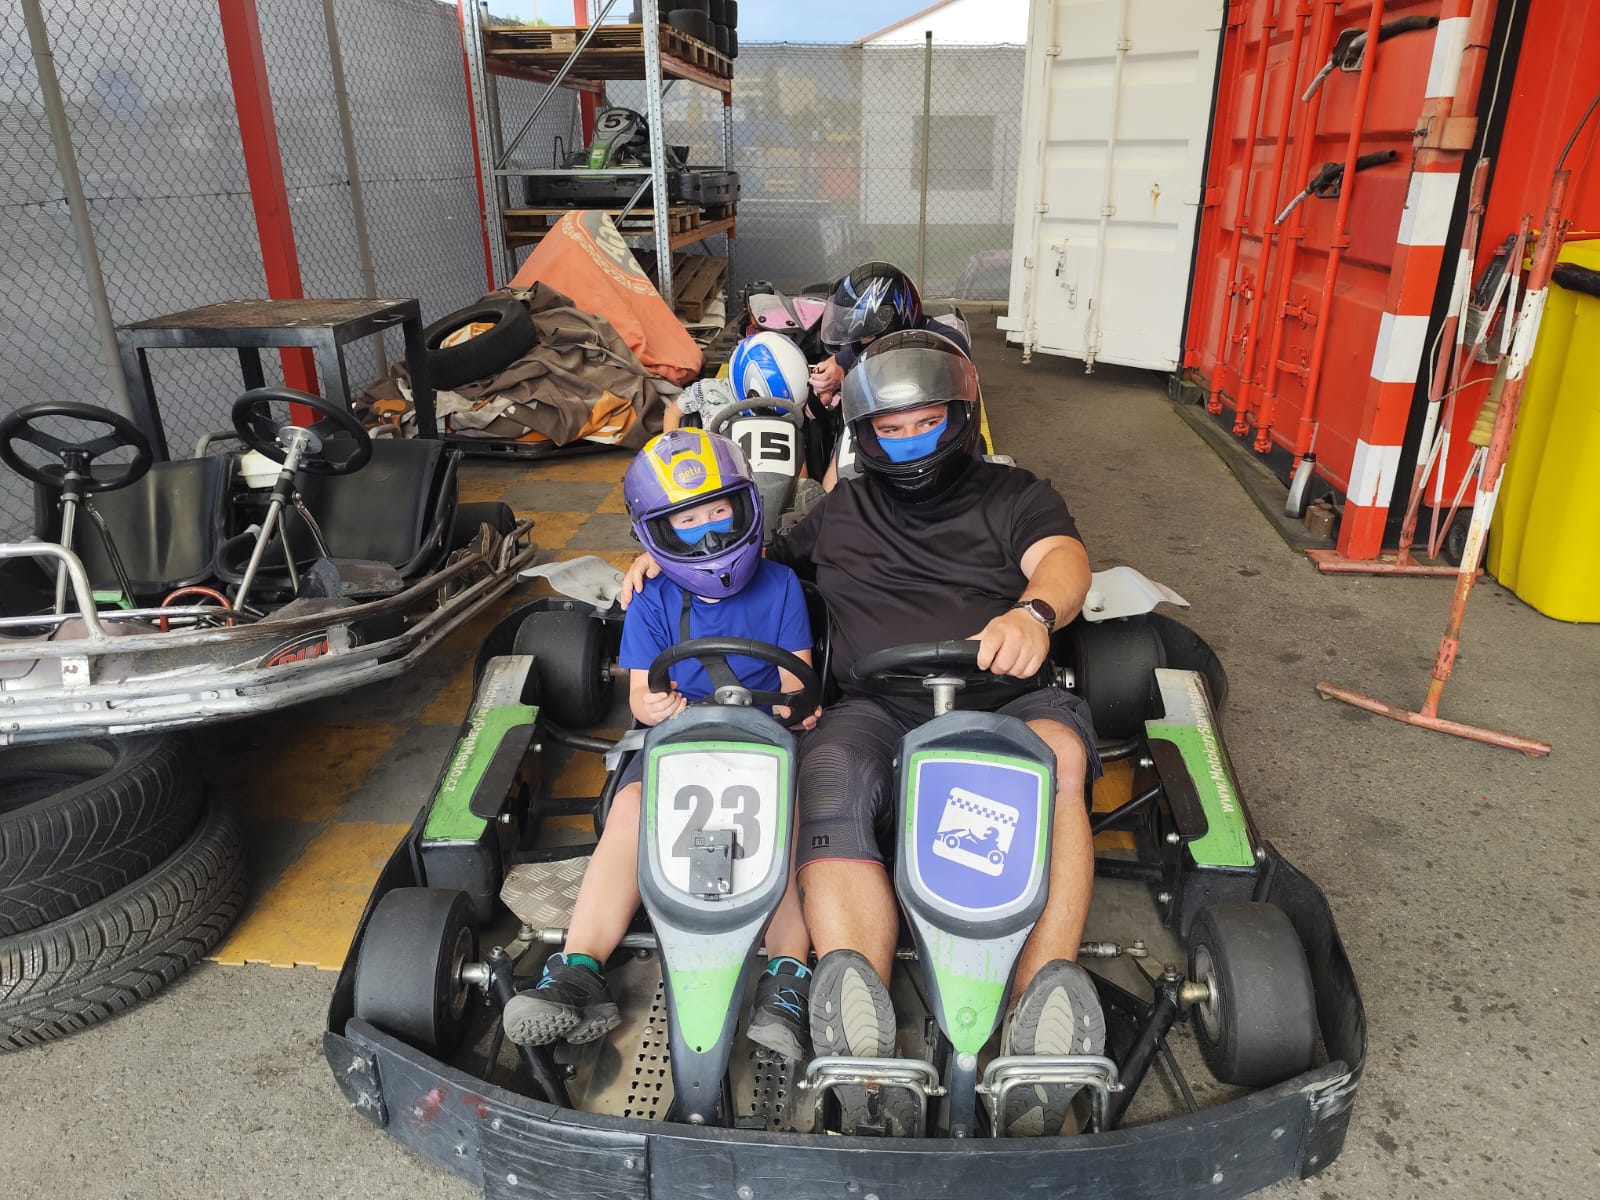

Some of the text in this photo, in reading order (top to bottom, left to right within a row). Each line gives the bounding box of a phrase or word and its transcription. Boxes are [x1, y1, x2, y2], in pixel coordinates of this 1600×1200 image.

[604, 114, 623, 128] 5
[738, 431, 791, 461] 15
[671, 784, 761, 859] 23
